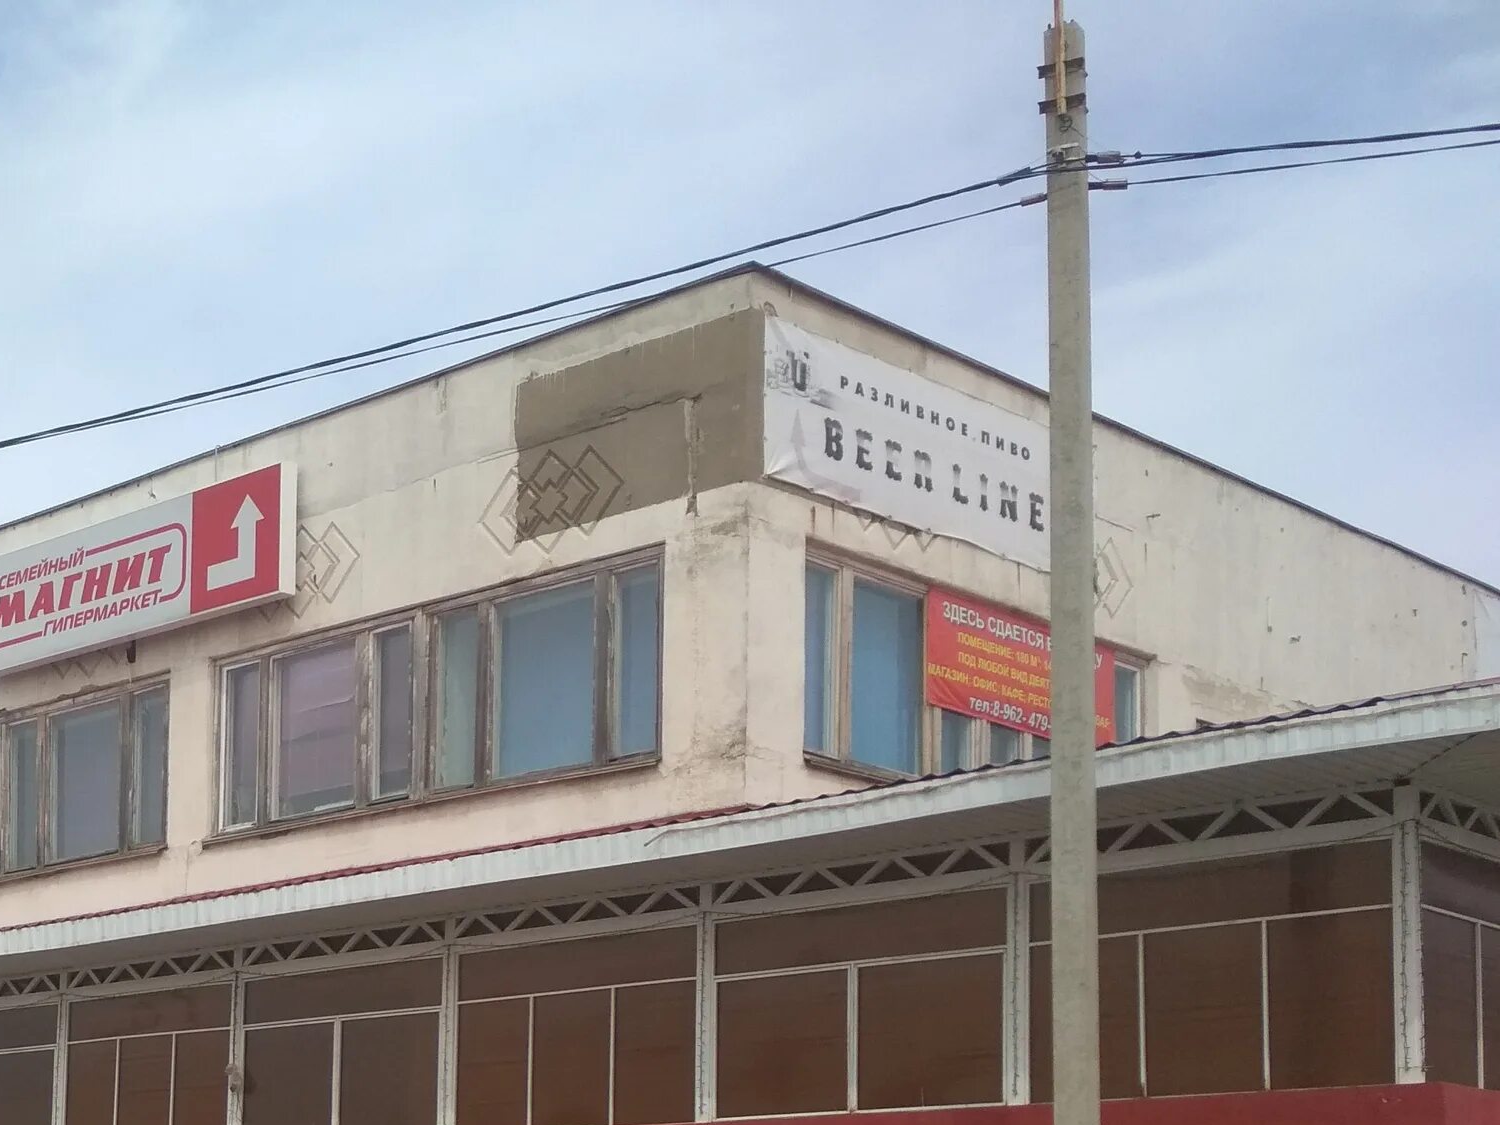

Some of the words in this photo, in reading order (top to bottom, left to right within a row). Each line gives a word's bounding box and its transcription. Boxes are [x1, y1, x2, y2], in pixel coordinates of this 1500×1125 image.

[840, 375, 968, 436] РАЗЛИВНОЕ
[981, 430, 1030, 461] ПИВО
[952, 463, 1045, 532] LINE
[0, 547, 85, 590] СЕМЕЙНЫЙ
[42, 588, 163, 637] ГИПЕРМАРКЕТ
[942, 601, 985, 628] ЗДЕСЬ
[988, 617, 1044, 649] СДАЕТСЯ
[958, 652, 977, 668] ПОД
[978, 657, 1009, 677] ЛЮБОЙ
[1010, 667, 1028, 683] ВИД
[1028, 672, 1052, 689] ДЕЯТ
